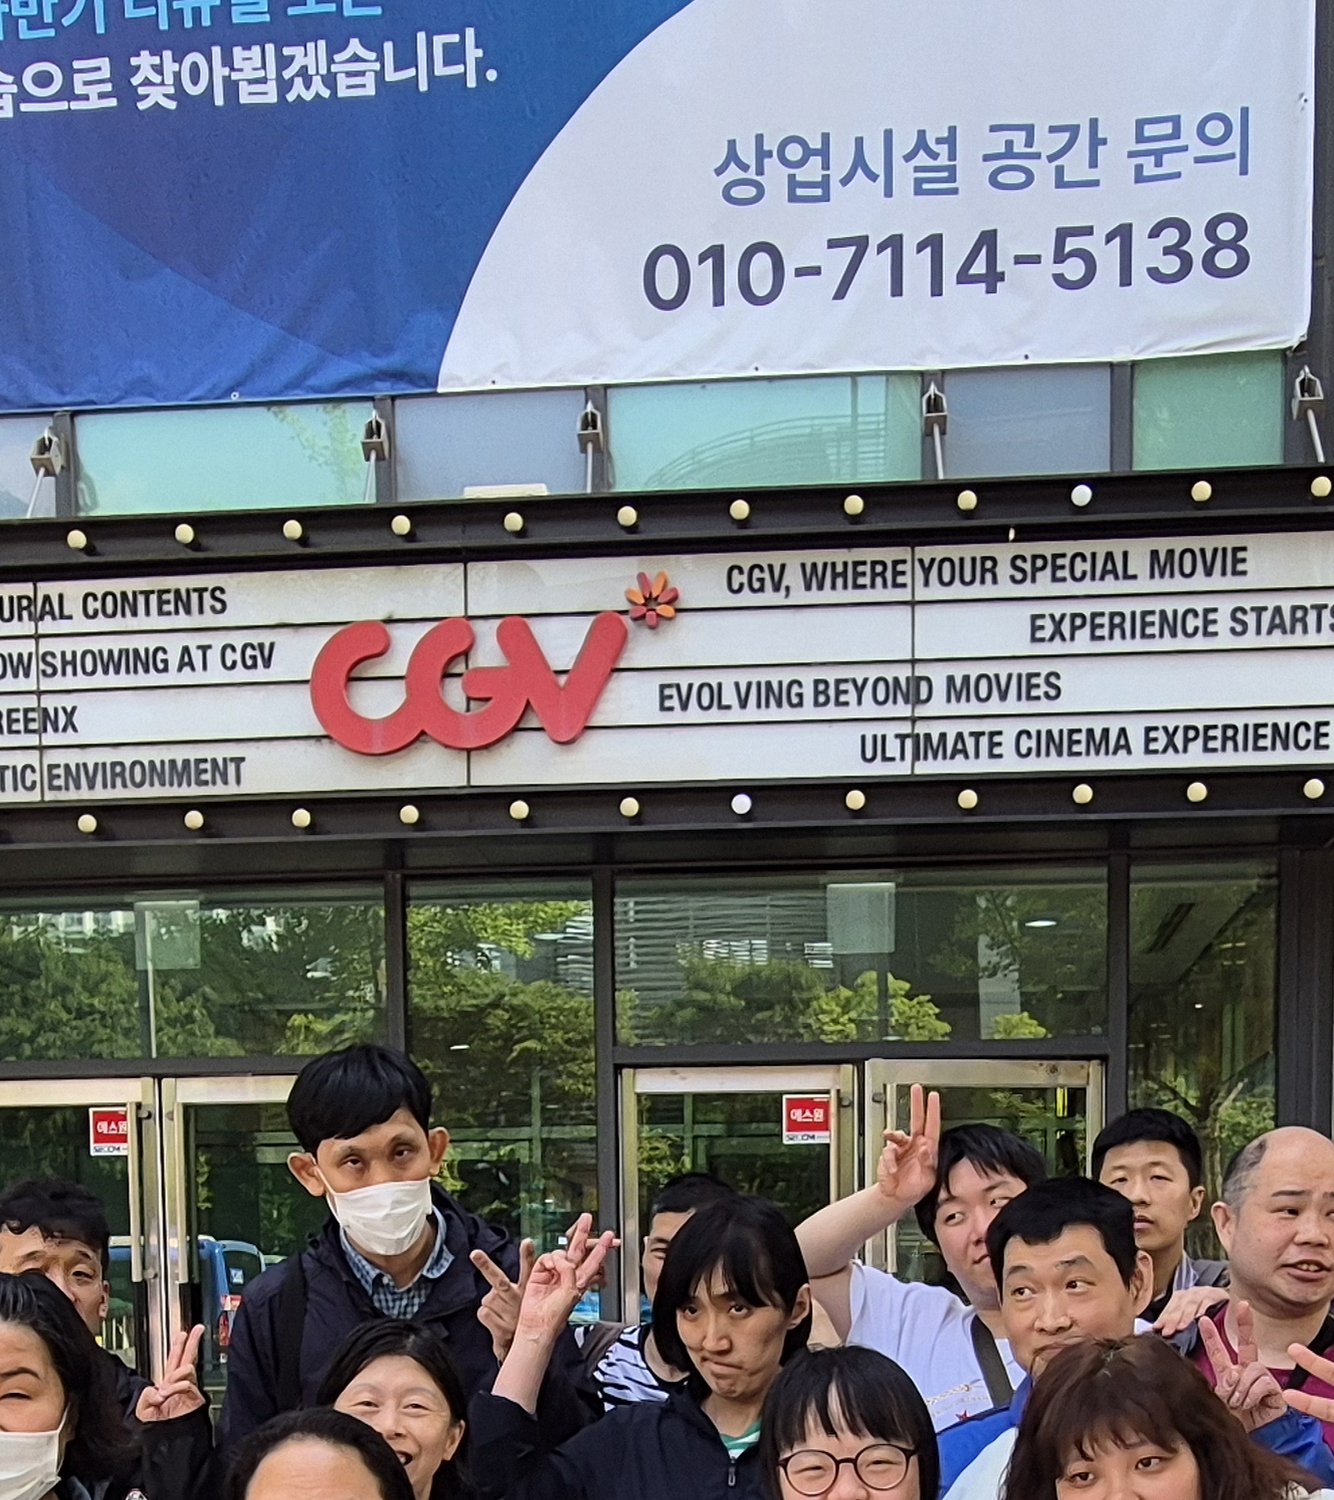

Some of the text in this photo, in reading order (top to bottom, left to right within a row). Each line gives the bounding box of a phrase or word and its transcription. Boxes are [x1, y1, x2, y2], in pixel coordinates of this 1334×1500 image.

[129, 27, 499, 111] 찾아뵙겠습니다.
[713, 106, 1251, 208] 상업시설 공간 문의
[642, 211, 1251, 312] 010-7114-5138
[726, 545, 1249, 600] CGV, WHERE YOUR SPECIAL MOVIE
[82, 585, 228, 620] CONTENTS
[1029, 607, 1219, 643] EXPERIENCE
[40, 646, 169, 678] SHOWING
[176, 644, 213, 673] AT
[220, 641, 276, 671] CGV
[310, 609, 629, 756] CGV
[659, 671, 1063, 712] EVOLVING BEYOND MOVIES
[860, 720, 1332, 764] ULTIMATE CINEMA EXPERIENCE
[46, 756, 247, 792] ENVIRONMENT
[789, 1108, 824, 1122] 에스원
